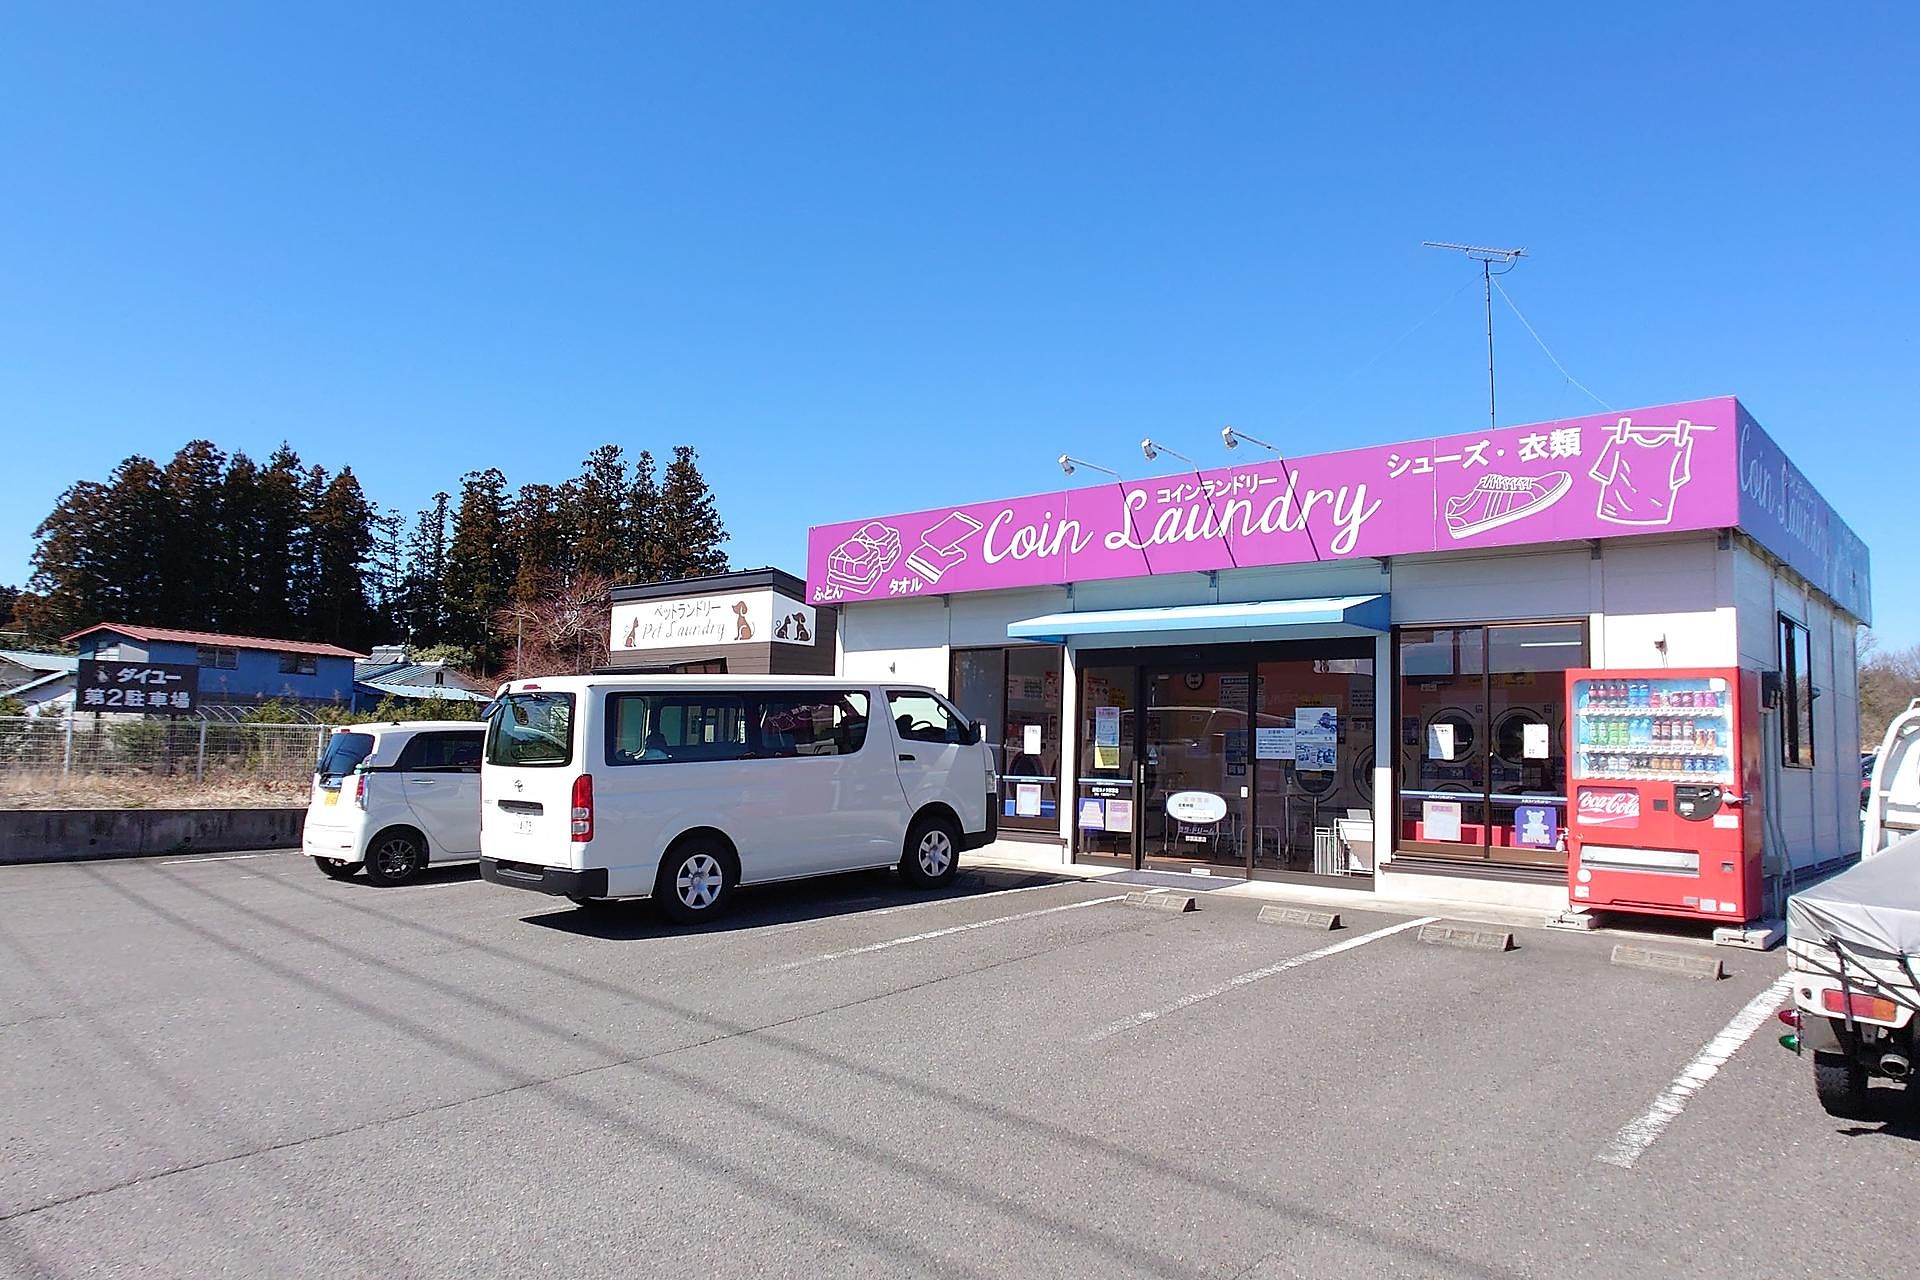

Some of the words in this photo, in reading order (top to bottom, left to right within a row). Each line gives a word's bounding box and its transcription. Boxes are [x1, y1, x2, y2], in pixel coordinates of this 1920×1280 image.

[1387, 427, 1582, 479] シューズ・衣類
[1156, 473, 1278, 504] コインランドリー
[982, 508, 1094, 564] Coin
[1104, 470, 1382, 555] Laundry
[813, 584, 844, 602] ふとん
[889, 577, 923, 595] タオル
[654, 600, 721, 620] ペットランドリー
[116, 667, 182, 684] ダイユー
[83, 687, 190, 709] 第2駐車場
[1578, 791, 1639, 816] Coca-Cola
